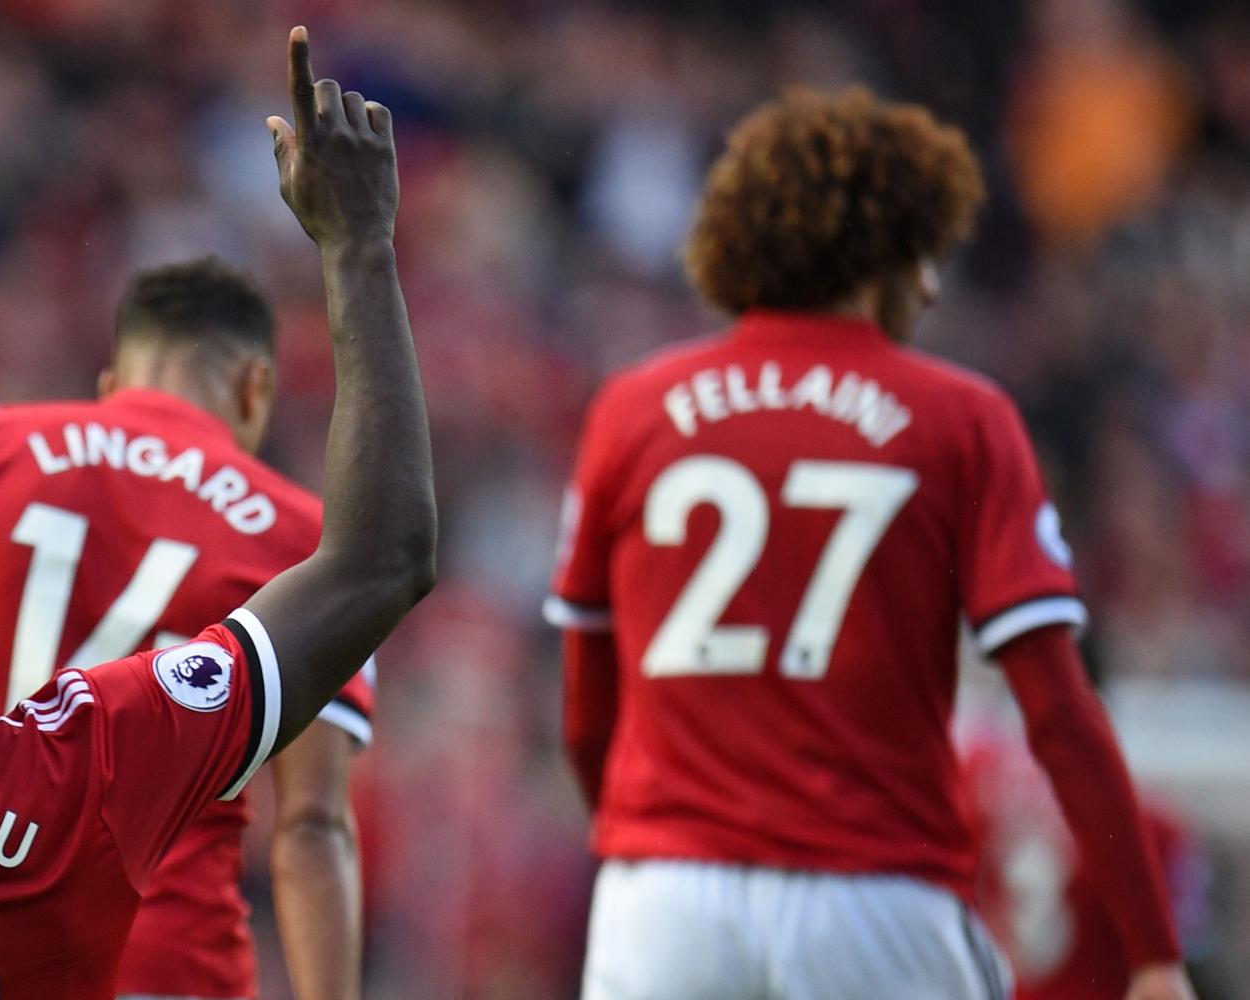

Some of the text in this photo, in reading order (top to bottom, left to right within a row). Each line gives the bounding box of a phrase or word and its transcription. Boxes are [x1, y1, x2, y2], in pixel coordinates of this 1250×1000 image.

[662, 360, 913, 448] FELLAINI
[28, 421, 278, 536] LINGARD
[641, 453, 921, 681] 27
